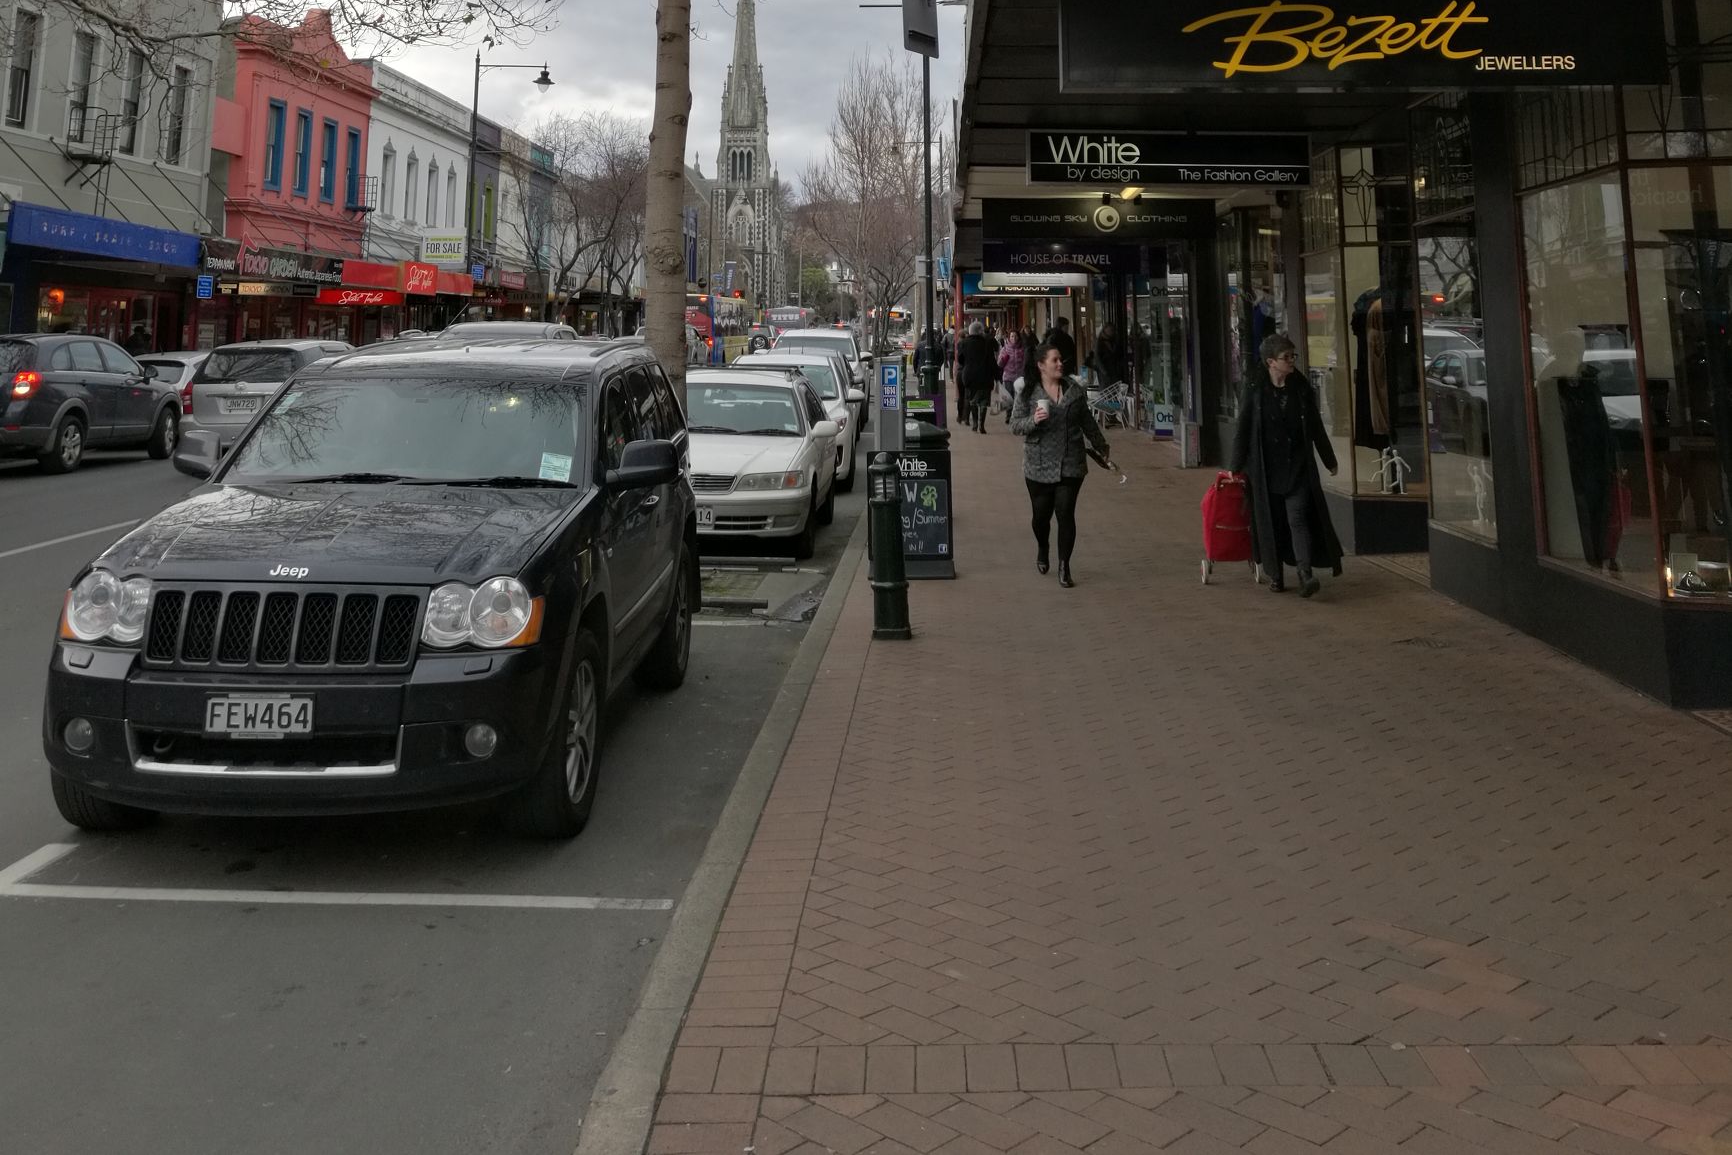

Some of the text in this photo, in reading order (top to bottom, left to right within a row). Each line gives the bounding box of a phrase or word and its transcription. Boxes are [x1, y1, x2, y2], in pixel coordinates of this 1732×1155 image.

[1180, 0, 1490, 79] Bezett
[1475, 55, 1576, 71] JEWELLERS
[1047, 135, 1141, 164] White
[1067, 166, 1140, 183] by design
[1178, 169, 1299, 183] The Fashion Gallery
[1010, 214, 1188, 223] GLOWING SKY CLOTHING
[425, 242, 462, 254] FOR SALE
[245, 253, 298, 278] TOKYO GARDEN
[1010, 254, 1112, 265] HOUSE OF TRAVEL
[333, 271, 342, 283] Food
[241, 285, 263, 293] TOKYO
[885, 367, 897, 384] P
[228, 399, 255, 408] JNW729
[1156, 411, 1173, 423] Orb
[269, 564, 309, 579] Jeep
[209, 702, 309, 729] FEW464
